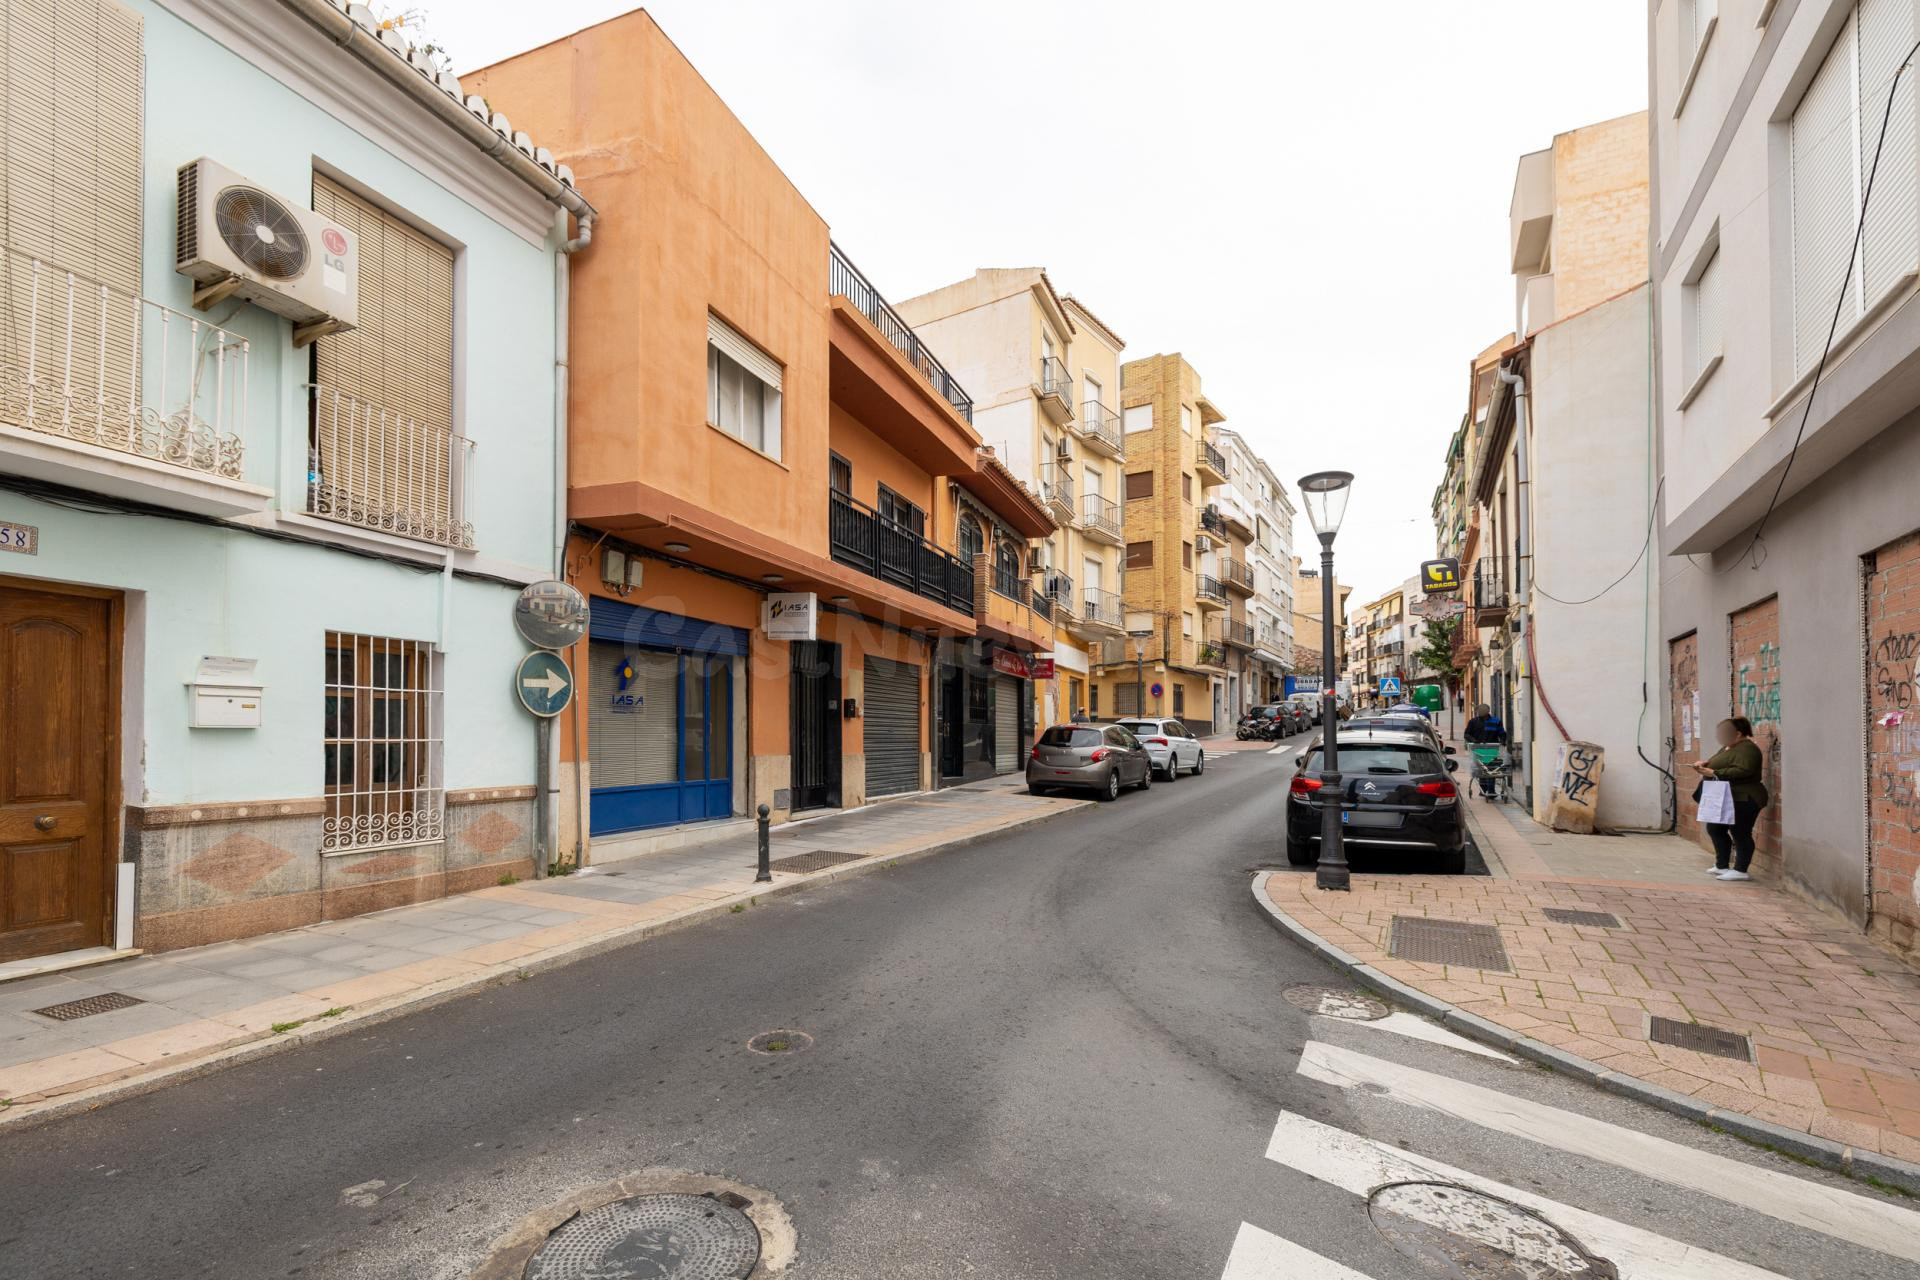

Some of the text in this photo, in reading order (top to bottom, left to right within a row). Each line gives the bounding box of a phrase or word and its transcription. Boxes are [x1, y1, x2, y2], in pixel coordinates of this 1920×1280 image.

[324, 253, 345, 273] LG
[0, 527, 26, 547] 58
[1425, 581, 1458, 590] TABACOS
[784, 603, 809, 611] IASA
[611, 695, 644, 705] IASA
